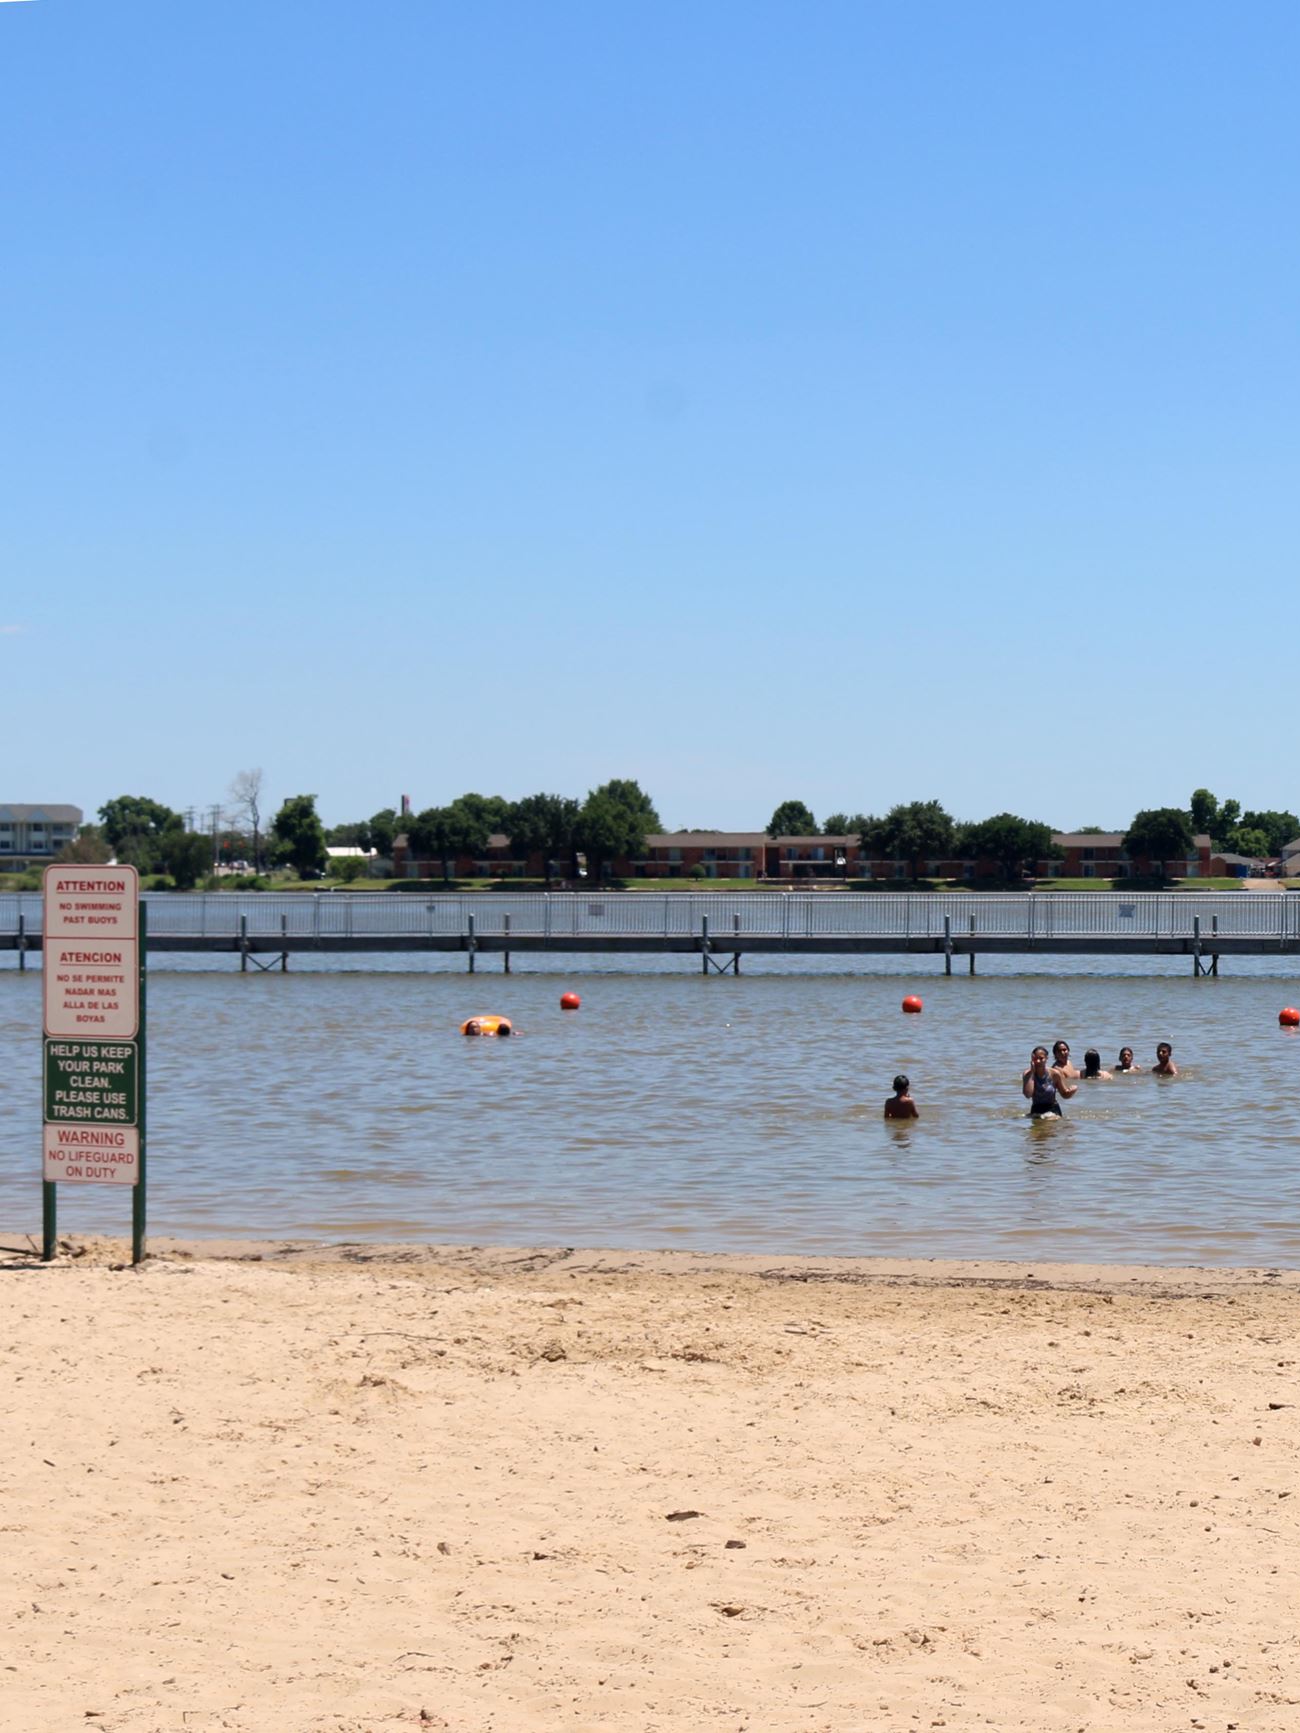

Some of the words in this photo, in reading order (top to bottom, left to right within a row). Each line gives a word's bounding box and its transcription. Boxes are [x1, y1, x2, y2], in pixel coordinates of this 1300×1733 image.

[56, 881, 125, 891] ATTENTION
[75, 903, 122, 911] SWIMMING
[87, 916, 118, 924] BUOYS
[60, 952, 122, 962] ATENCION
[56, 974, 70, 982] NO
[86, 975, 124, 983] PERMITE
[63, 1001, 85, 1009] ALLA
[102, 1002, 119, 1010] LAS
[50, 1045, 80, 1056] HELP
[82, 1046, 98, 1057] US
[101, 1047, 132, 1058] KEEP
[58, 1060, 90, 1072] YOUR
[92, 1062, 124, 1073] PARK
[70, 1076, 112, 1088] CLEAN.
[55, 1090, 100, 1103] PLEASE
[103, 1092, 127, 1104] USE
[53, 1105, 91, 1117] TRASH
[94, 1107, 129, 1119] CANS.
[57, 1130, 125, 1145] WARNING
[48, 1150, 65, 1160] NO
[68, 1151, 134, 1164] LIFEGUARD
[66, 1166, 82, 1176] ON
[86, 1167, 116, 1178] DUTY
